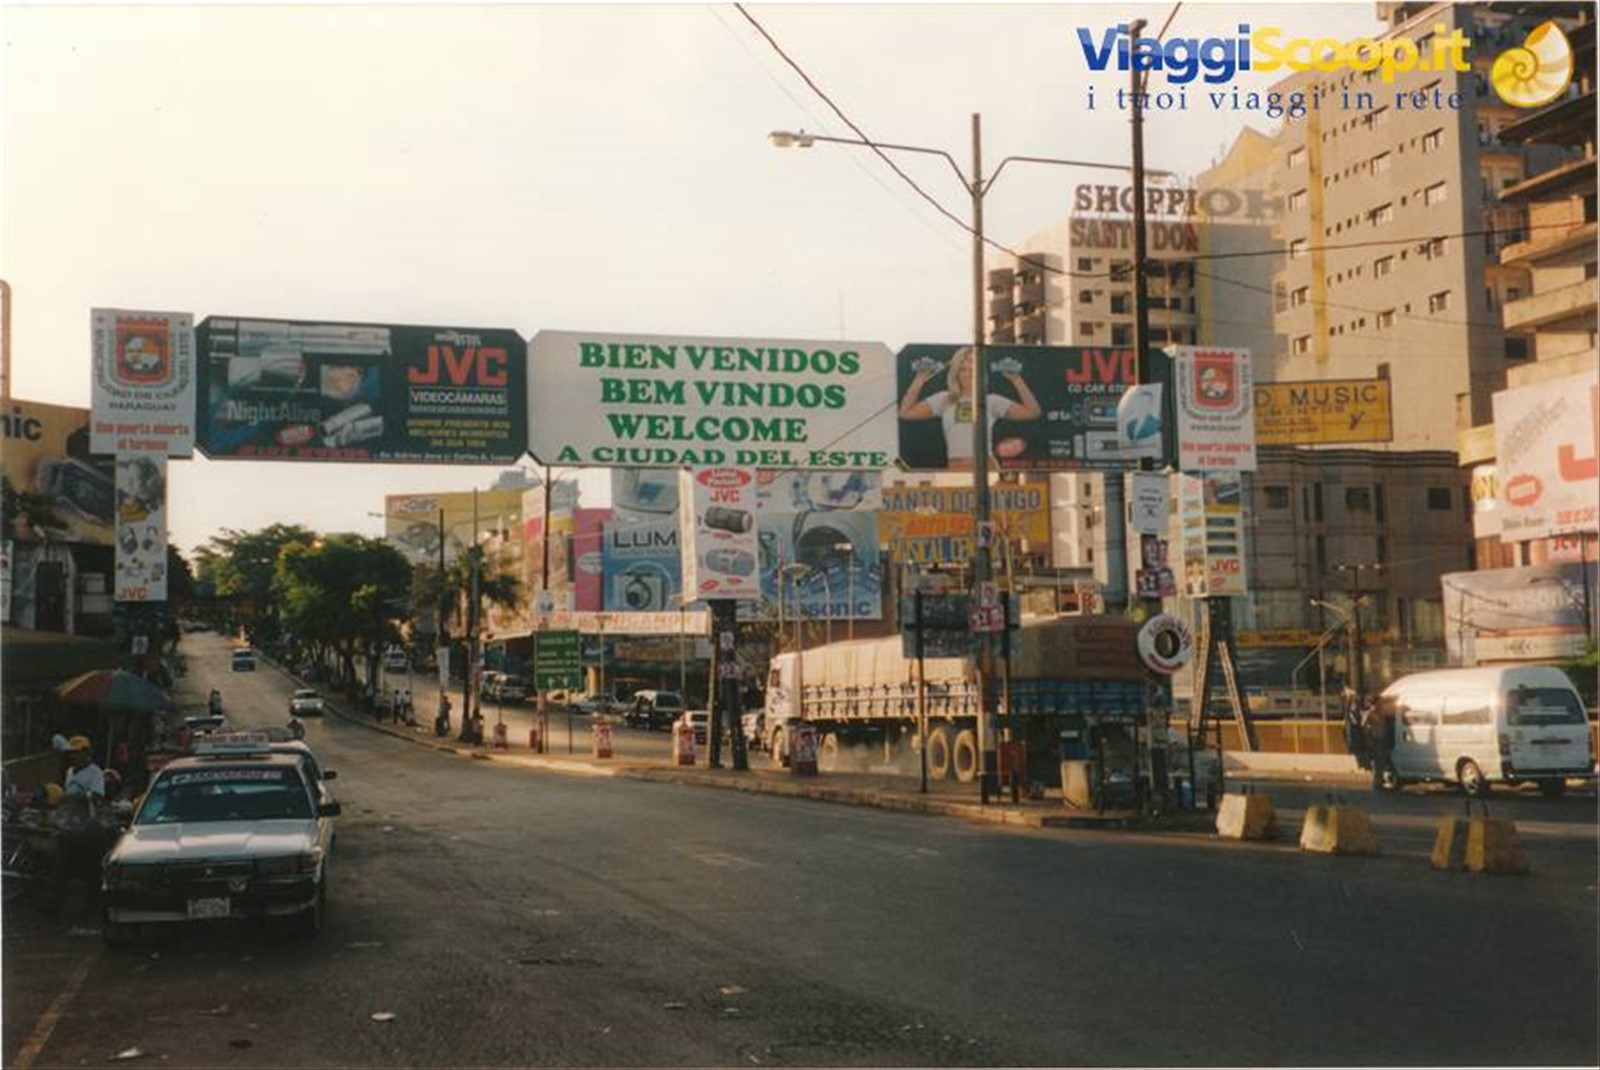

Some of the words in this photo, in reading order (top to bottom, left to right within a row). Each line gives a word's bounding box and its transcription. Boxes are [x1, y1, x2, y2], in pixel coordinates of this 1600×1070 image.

[407, 345, 508, 385] JVC
[600, 378, 686, 405] BEM
[693, 381, 847, 409] VINDOS
[1290, 384, 1378, 406] MUSIC
[606, 413, 808, 443] WELCOME
[557, 445, 581, 462] A
[591, 446, 726, 466] CIUDAD
[735, 449, 799, 466] DEL
[808, 450, 887, 467] ESTE
[710, 488, 740, 503] JVC
[882, 488, 945, 512] SANTO
[951, 488, 1042, 511] DOINGO
[1210, 559, 1239, 571] JVC
[117, 586, 148, 600] JVC
